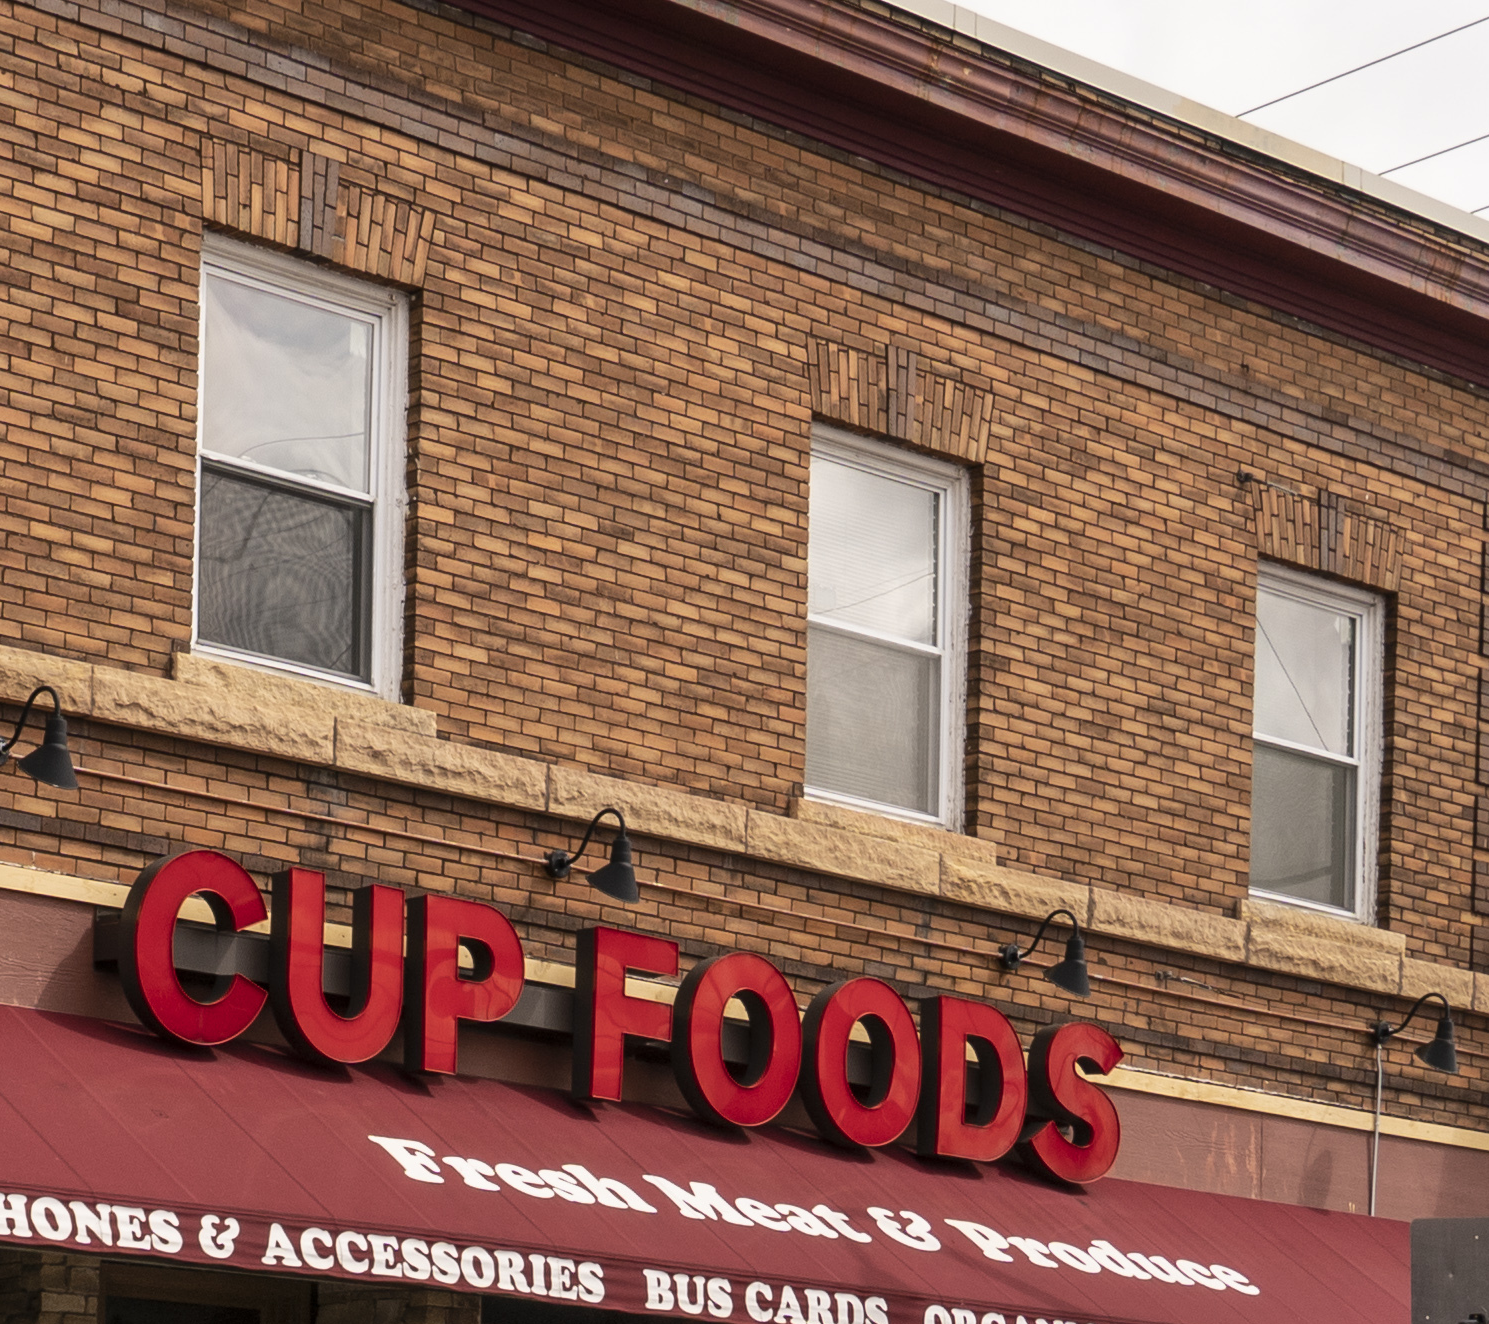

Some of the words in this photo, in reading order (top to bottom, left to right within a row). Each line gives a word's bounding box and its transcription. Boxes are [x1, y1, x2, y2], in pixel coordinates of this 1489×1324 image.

[120, 848, 525, 1074] CUP
[573, 925, 1124, 1184] FOODS
[198, 1214, 240, 1259] &
[261, 1220, 605, 1305] ACCESSORIES
[644, 1272, 735, 1320] BUS
[367, 1134, 655, 1213] Fresh
[642, 1173, 871, 1245] Meat
[867, 1206, 943, 1252] &
[945, 1215, 1261, 1297] Produce
